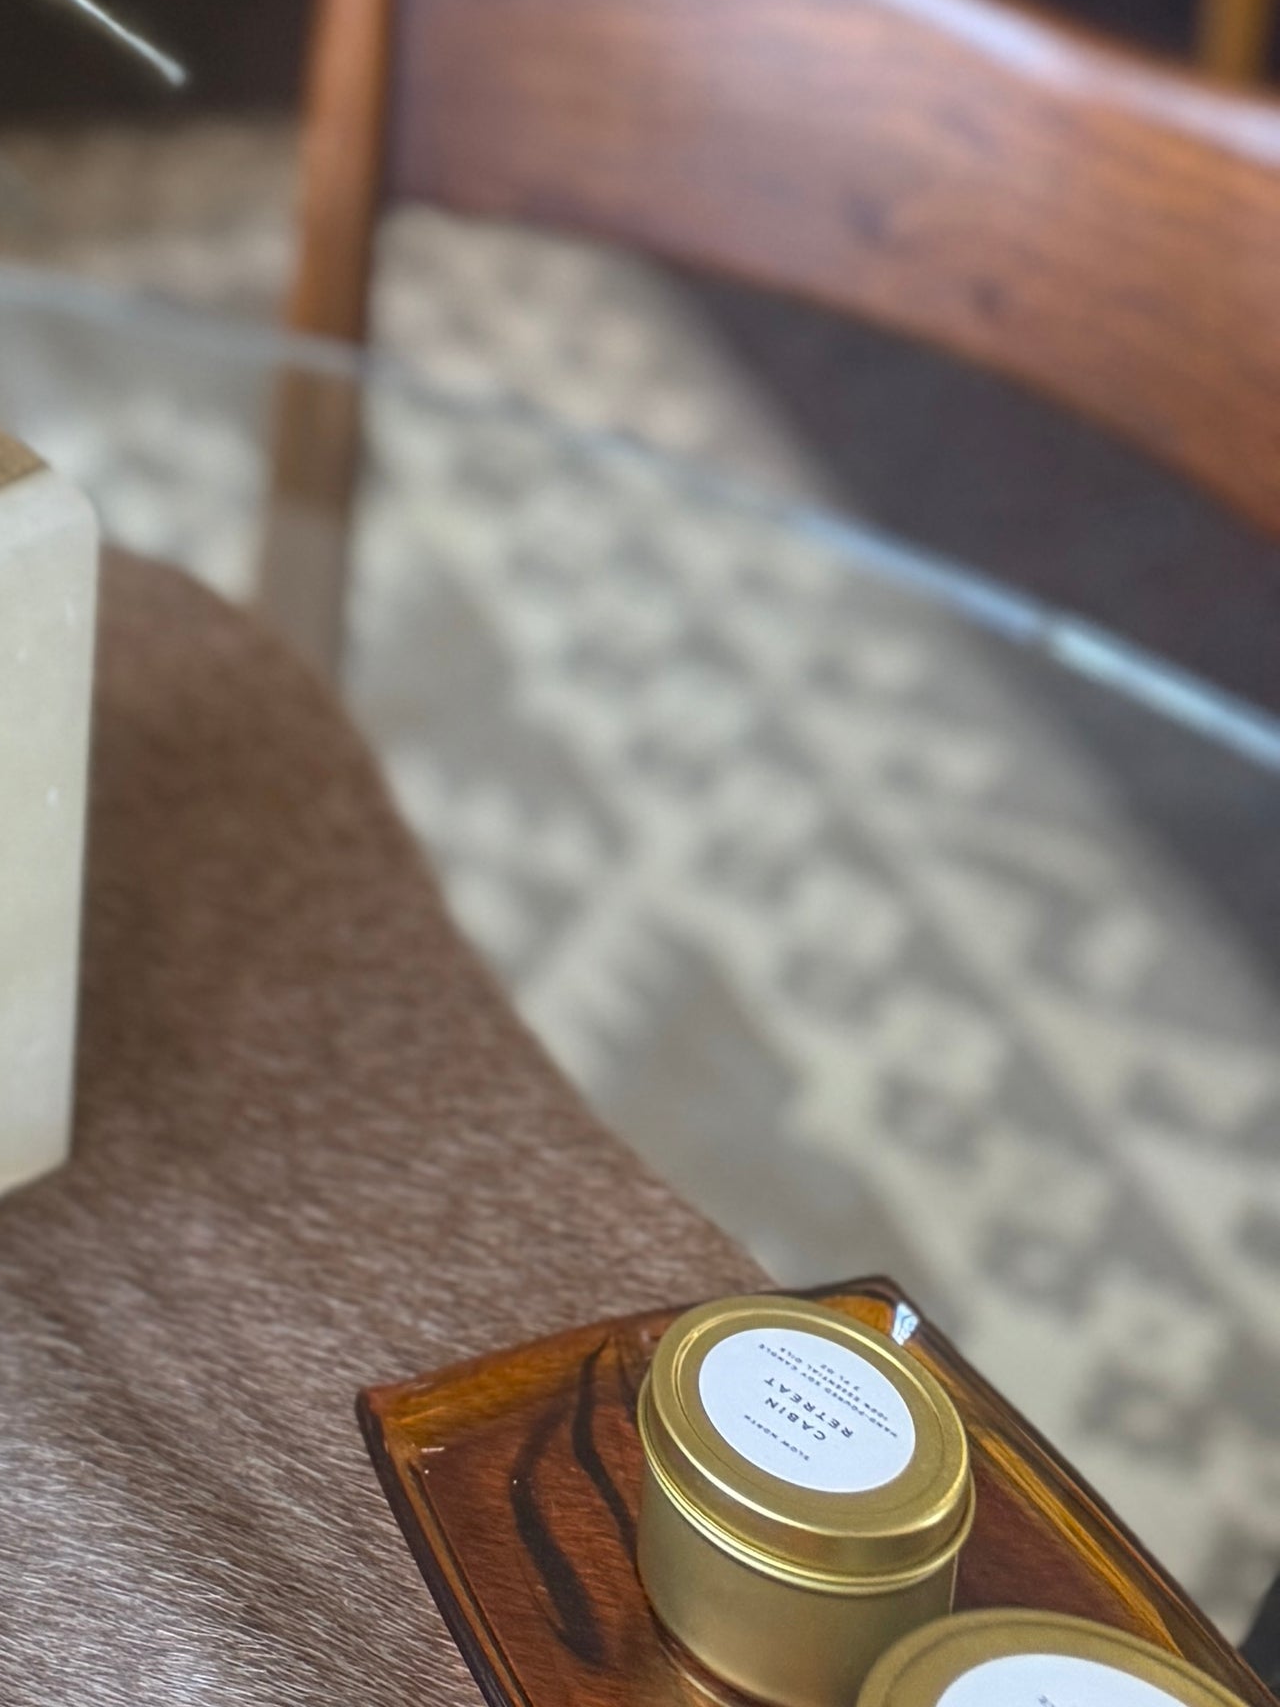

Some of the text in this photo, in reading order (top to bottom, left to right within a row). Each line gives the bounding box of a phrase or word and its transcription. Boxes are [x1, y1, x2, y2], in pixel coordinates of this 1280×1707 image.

[779, 1346, 803, 1364] OILS
[758, 1343, 898, 1438] HAND-POURED SOY CANDLE
[807, 1363, 861, 1403] ESSENTIAL
[743, 1414, 779, 1440] NORTH
[763, 1377, 854, 1439] RETREAT
[764, 1397, 827, 1441] CABIN
